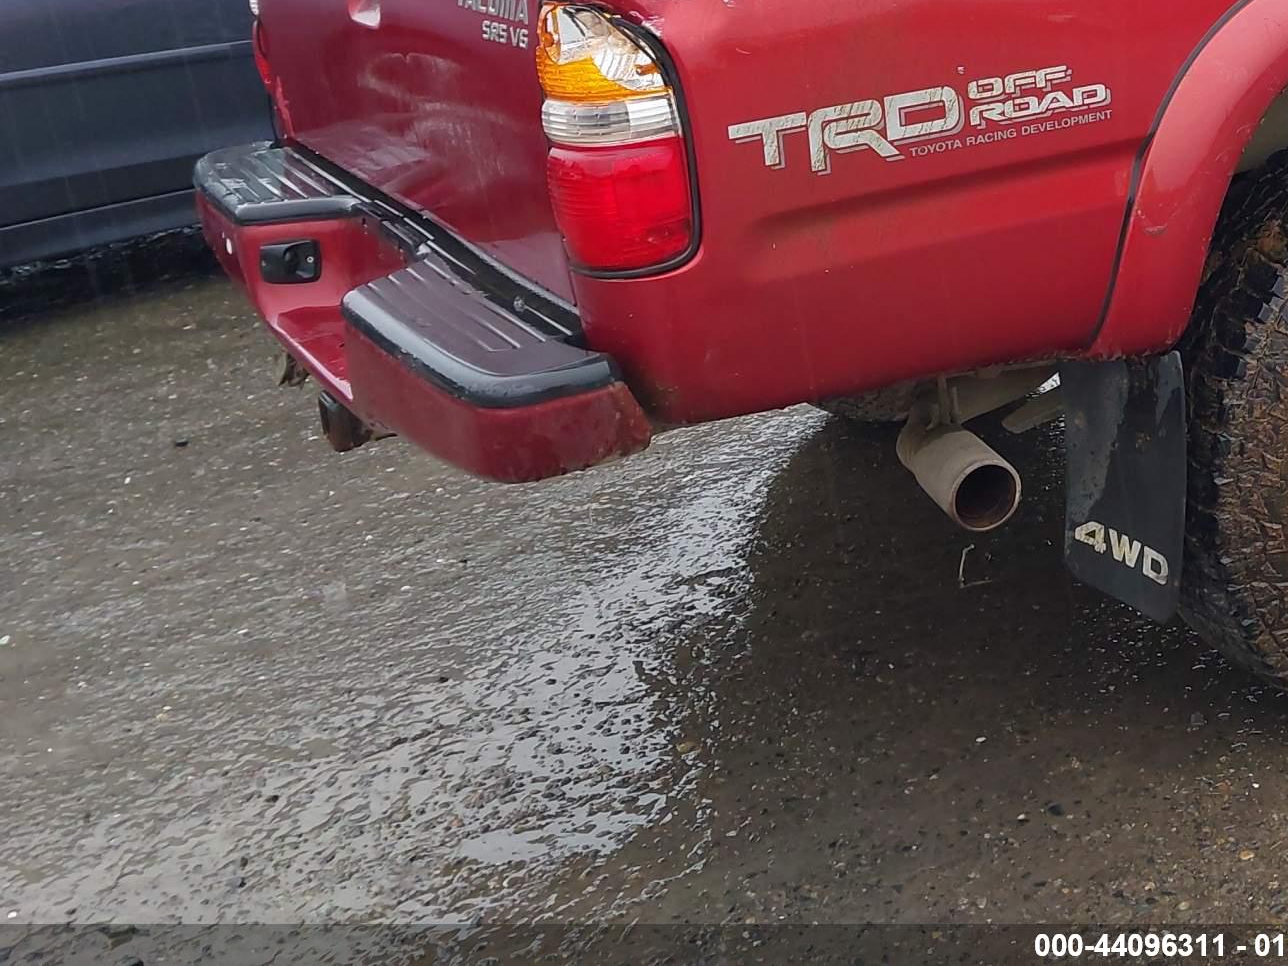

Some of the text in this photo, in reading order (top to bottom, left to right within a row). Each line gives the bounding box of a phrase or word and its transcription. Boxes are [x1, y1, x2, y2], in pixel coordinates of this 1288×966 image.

[509, 26, 529, 49] V6
[967, 65, 1073, 102] OFF
[969, 83, 1112, 129] ROAD
[727, 85, 967, 176] TRD
[909, 109, 1113, 157] TOYOTA RACING DEVELOPMENT
[1074, 521, 1169, 586] 4WD
